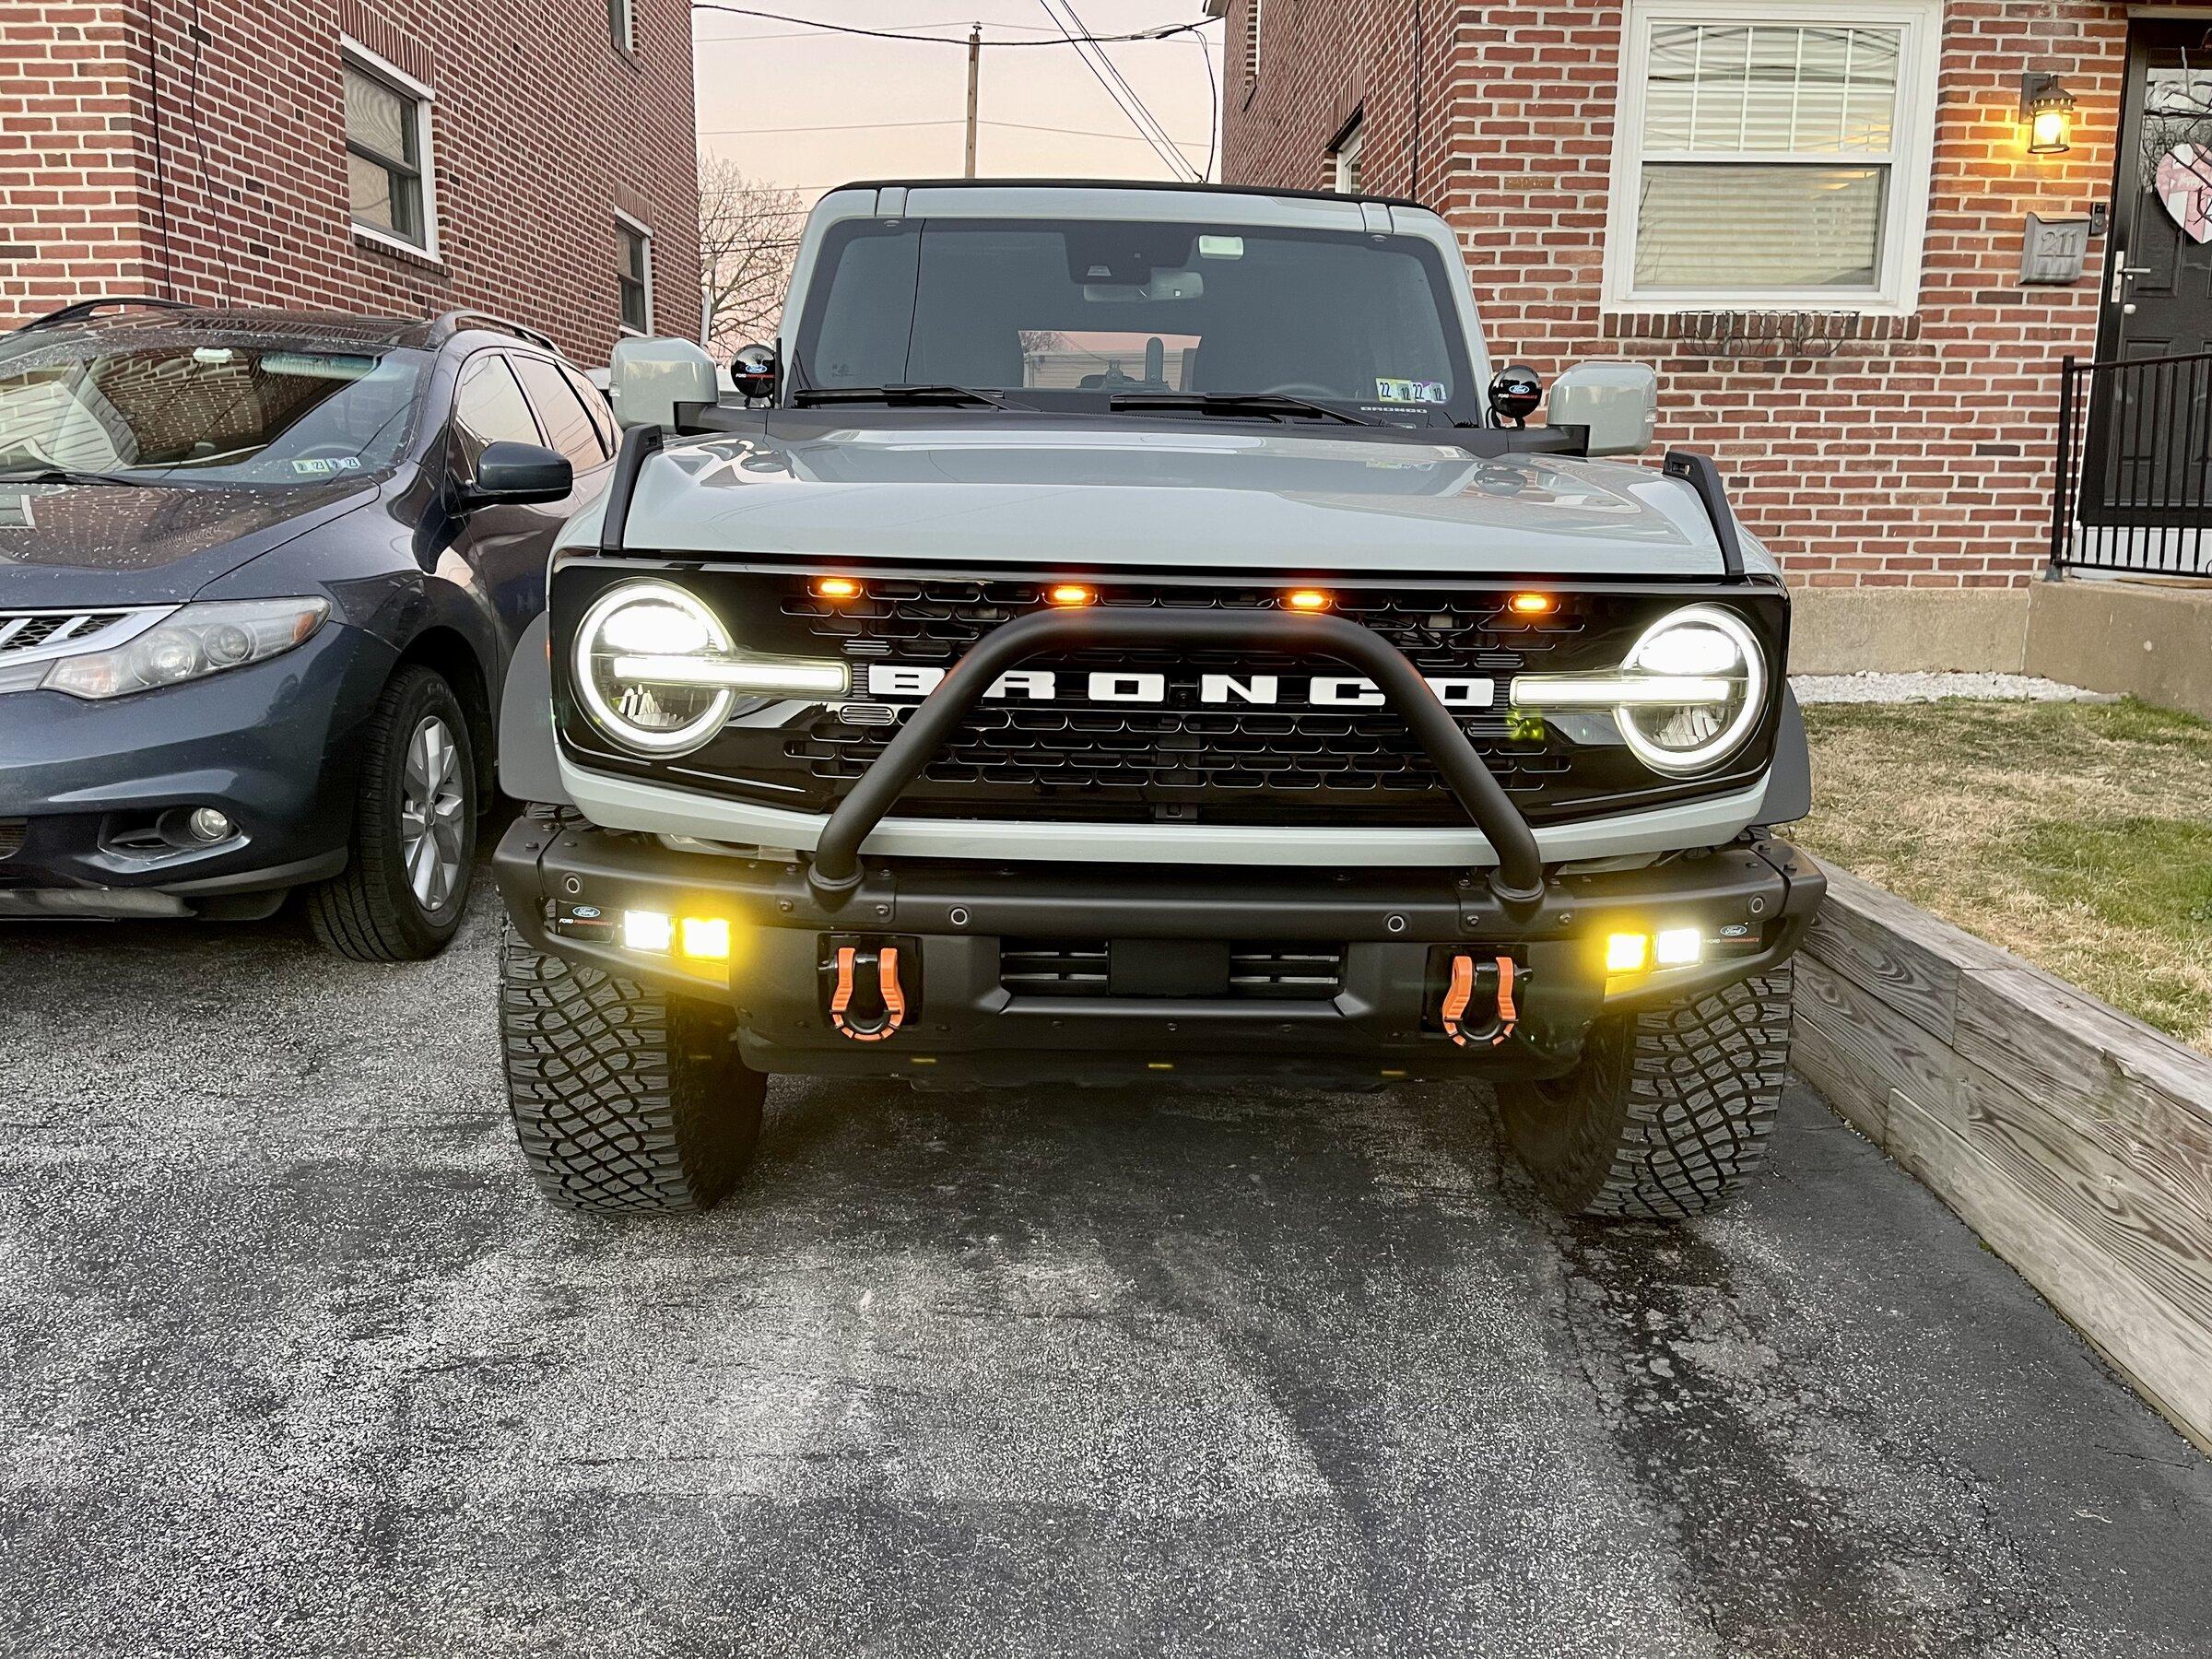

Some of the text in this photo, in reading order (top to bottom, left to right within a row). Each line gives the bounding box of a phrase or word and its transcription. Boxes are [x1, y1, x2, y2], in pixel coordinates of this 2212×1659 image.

[2039, 229, 2077, 257] 211
[1380, 382, 1411, 401] 22 12
[1412, 383, 1425, 400] 22
[868, 665, 1495, 707] BRONCO
